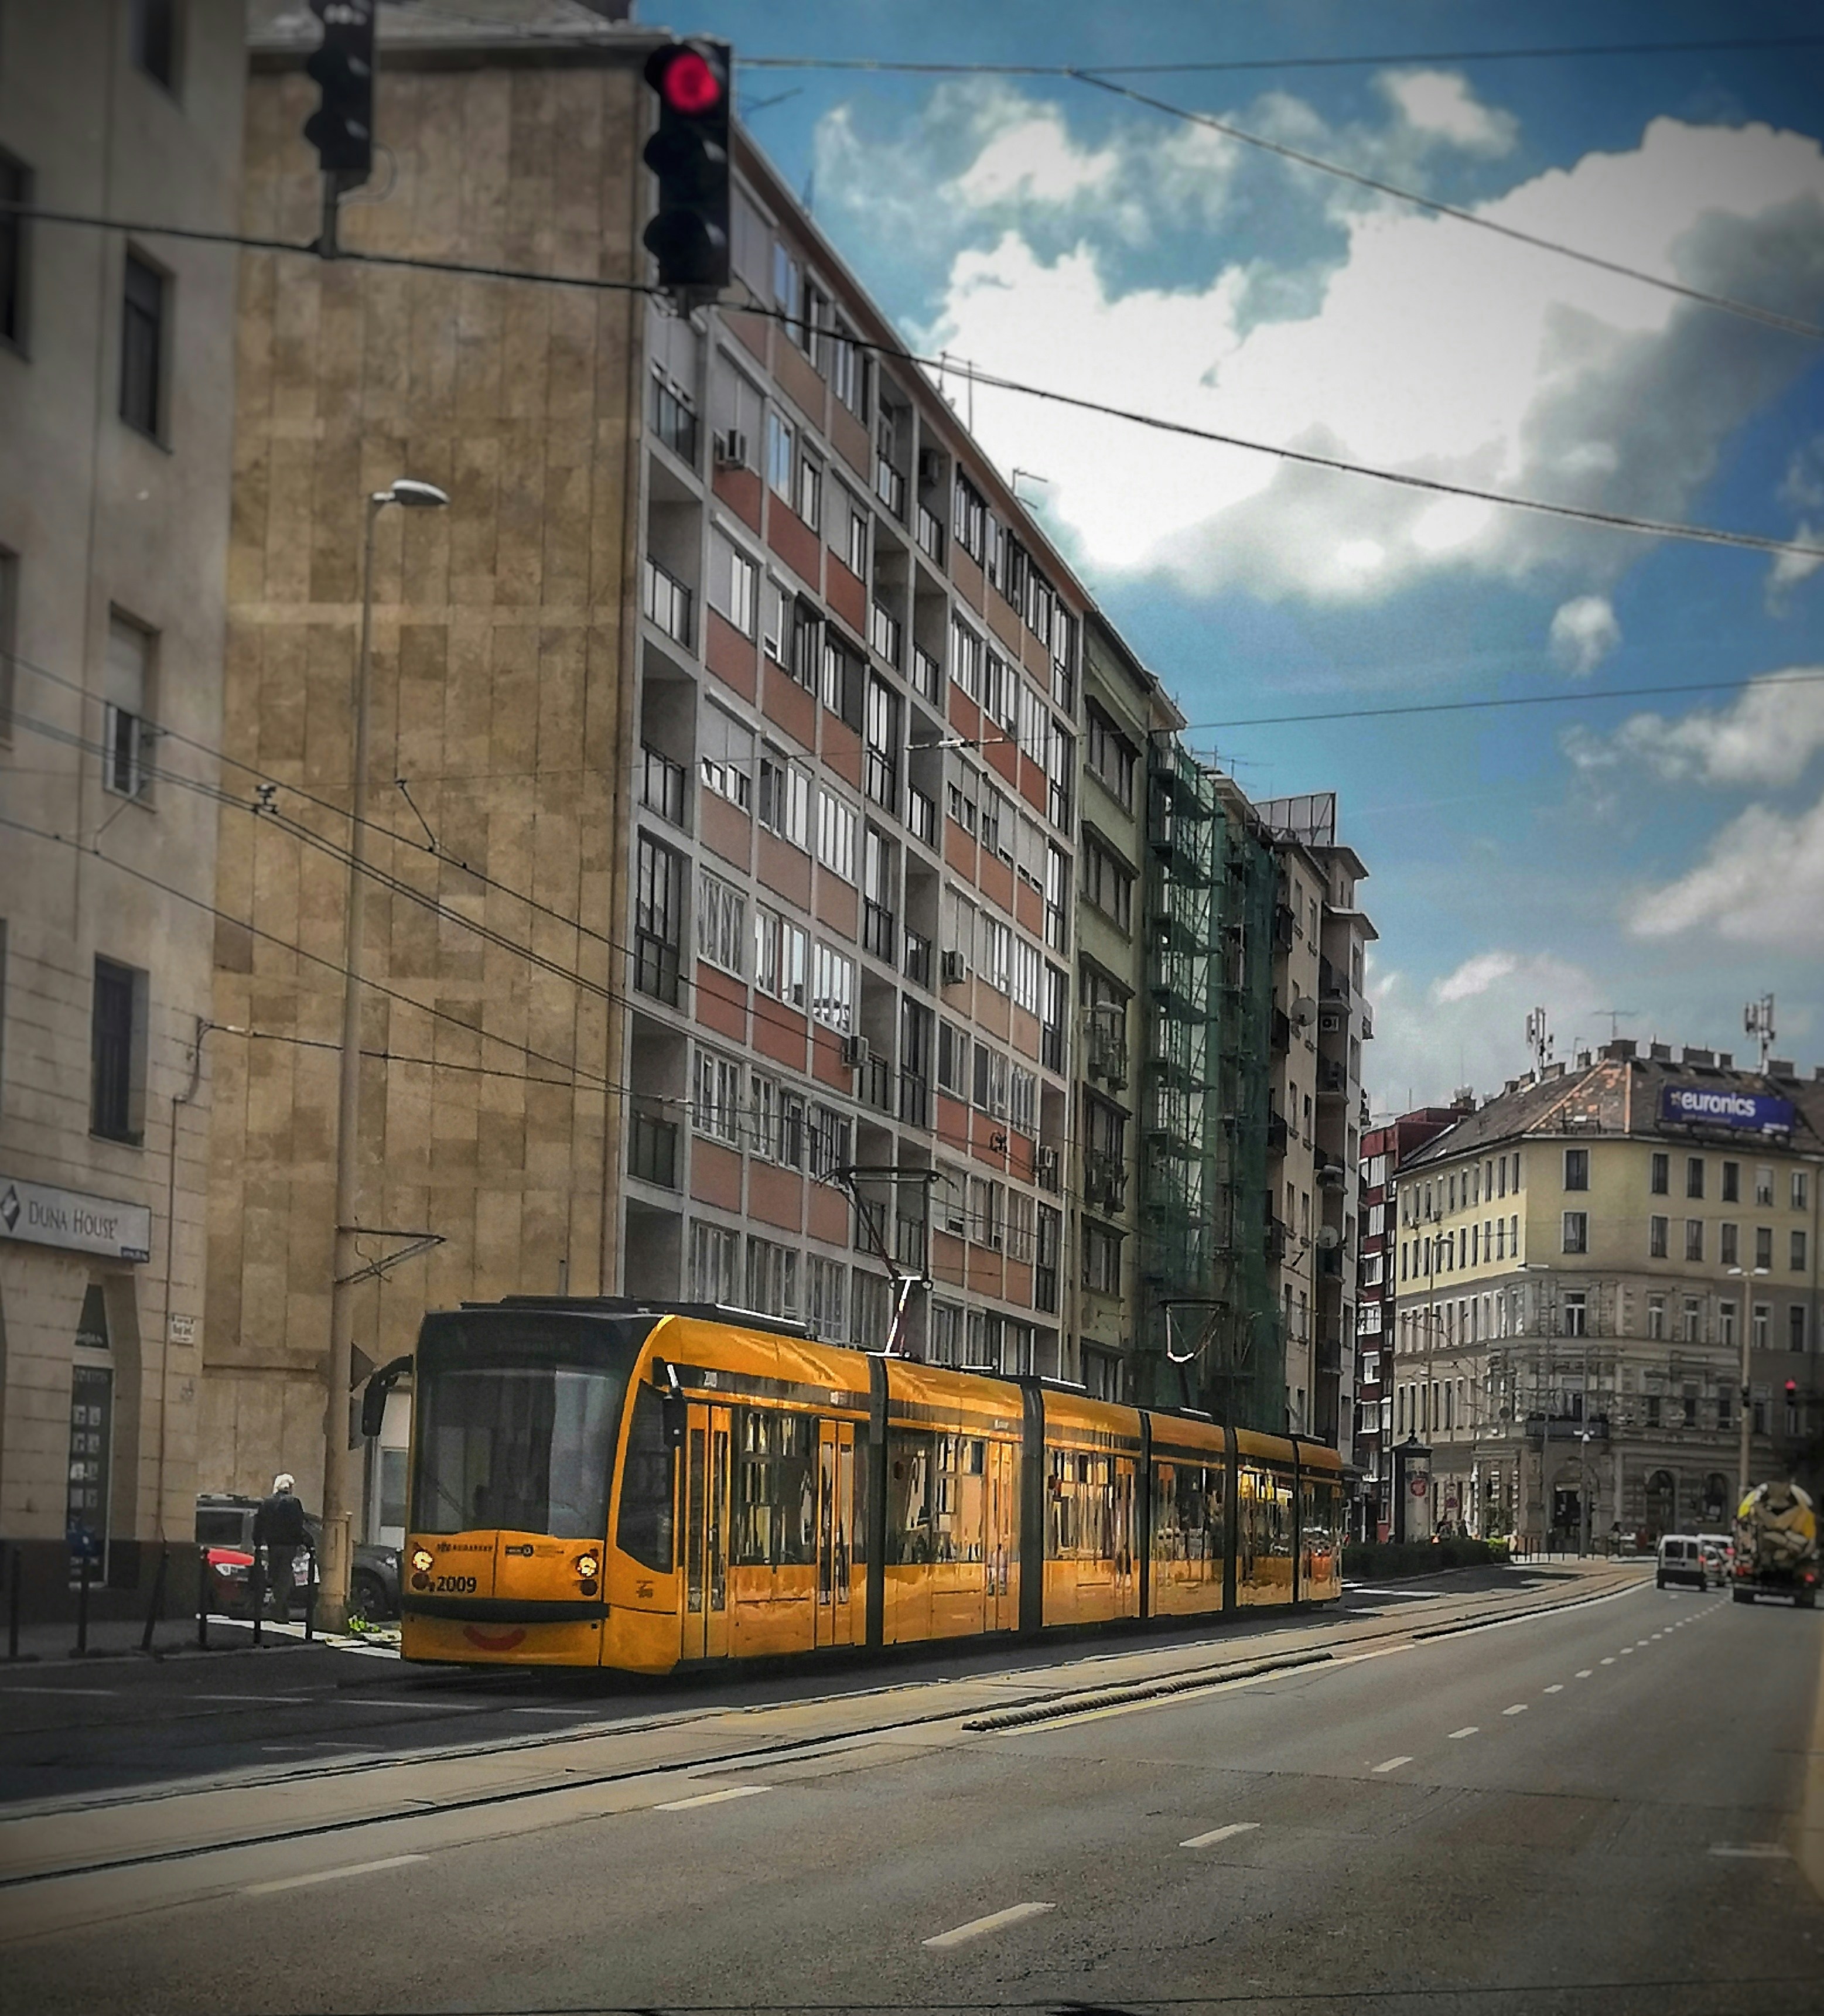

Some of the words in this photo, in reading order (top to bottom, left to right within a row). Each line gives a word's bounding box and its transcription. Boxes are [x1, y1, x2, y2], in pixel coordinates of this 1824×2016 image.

[1680, 1092, 1756, 1117] euronics
[29, 1201, 68, 1231] DUNA
[436, 1576, 477, 1594] 2009
